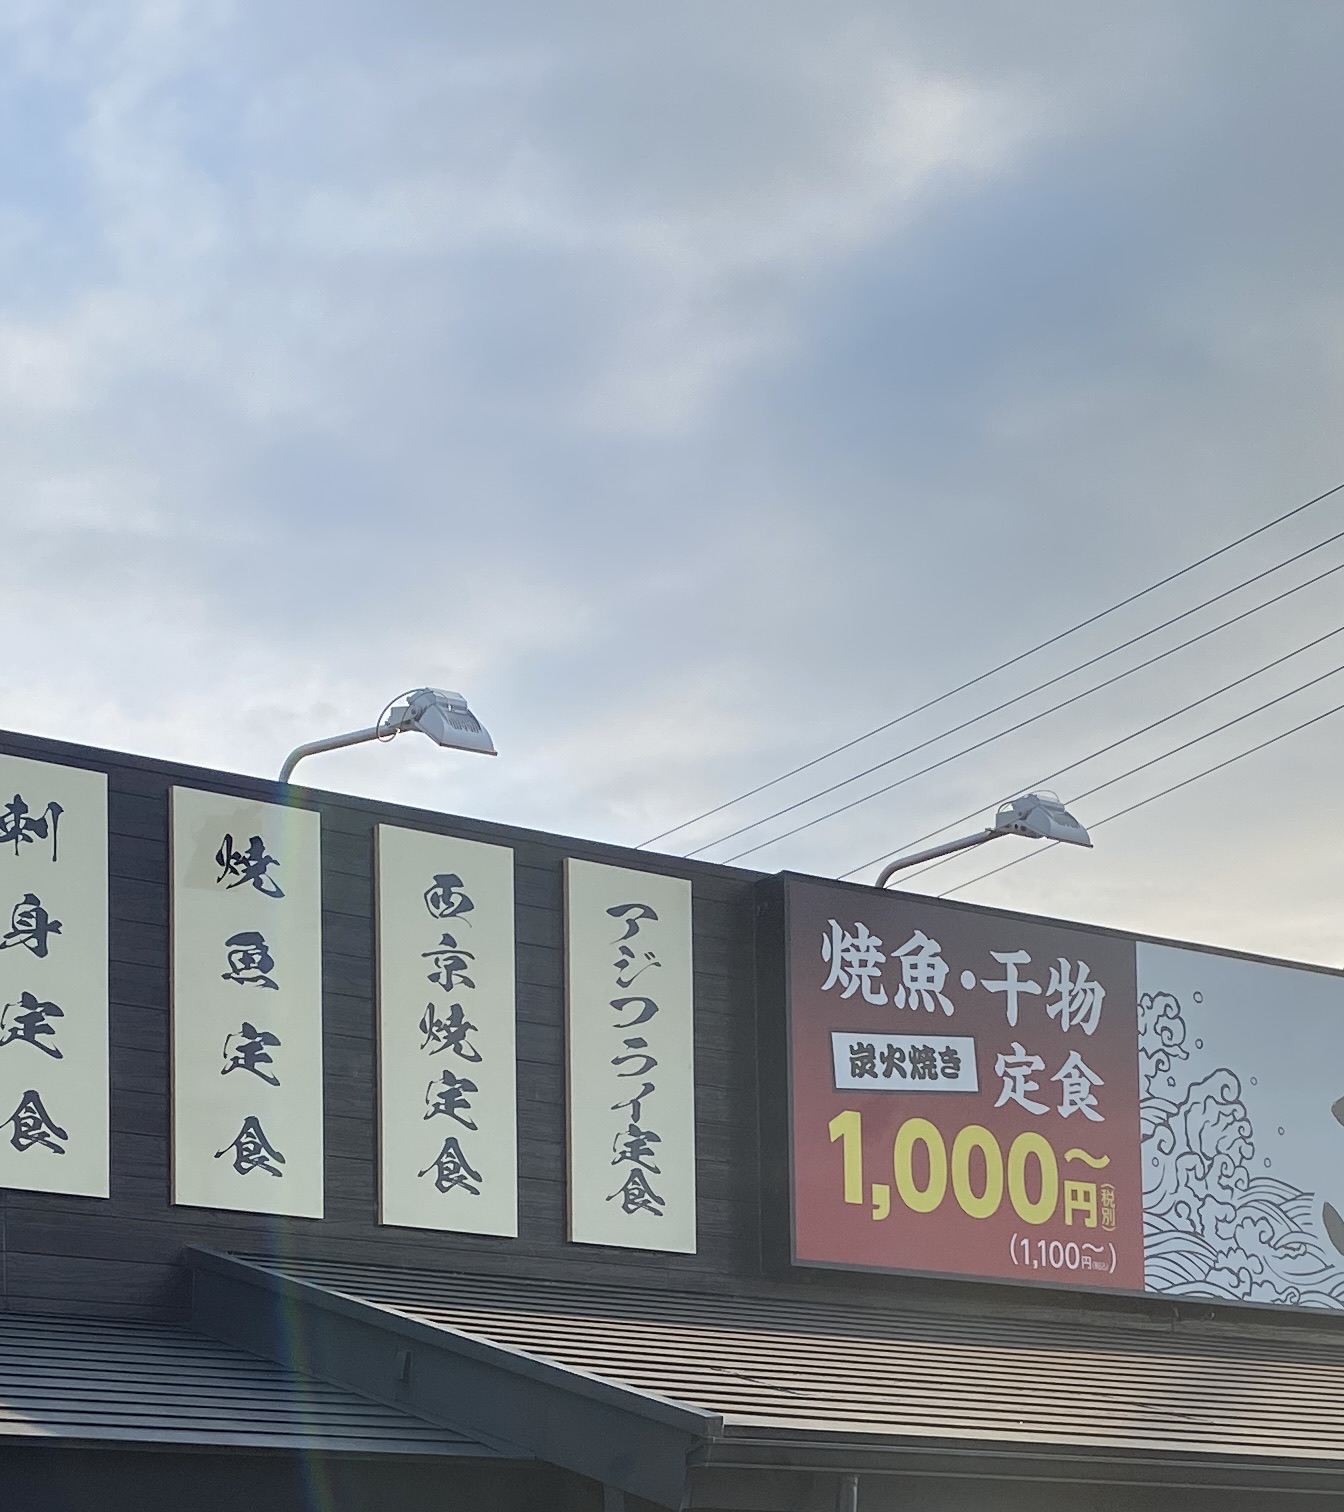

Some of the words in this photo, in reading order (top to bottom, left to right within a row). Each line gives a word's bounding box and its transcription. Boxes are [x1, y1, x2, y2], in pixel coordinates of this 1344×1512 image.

[214, 833, 286, 1179] 焼魚定食
[417, 874, 483, 1196] 西京焼定食
[605, 902, 665, 1217] アジフライ定食
[820, 918, 1106, 1036] 焼魚・干物
[848, 1041, 962, 1081] 炭火焼き
[993, 1042, 1106, 1122] 定食
